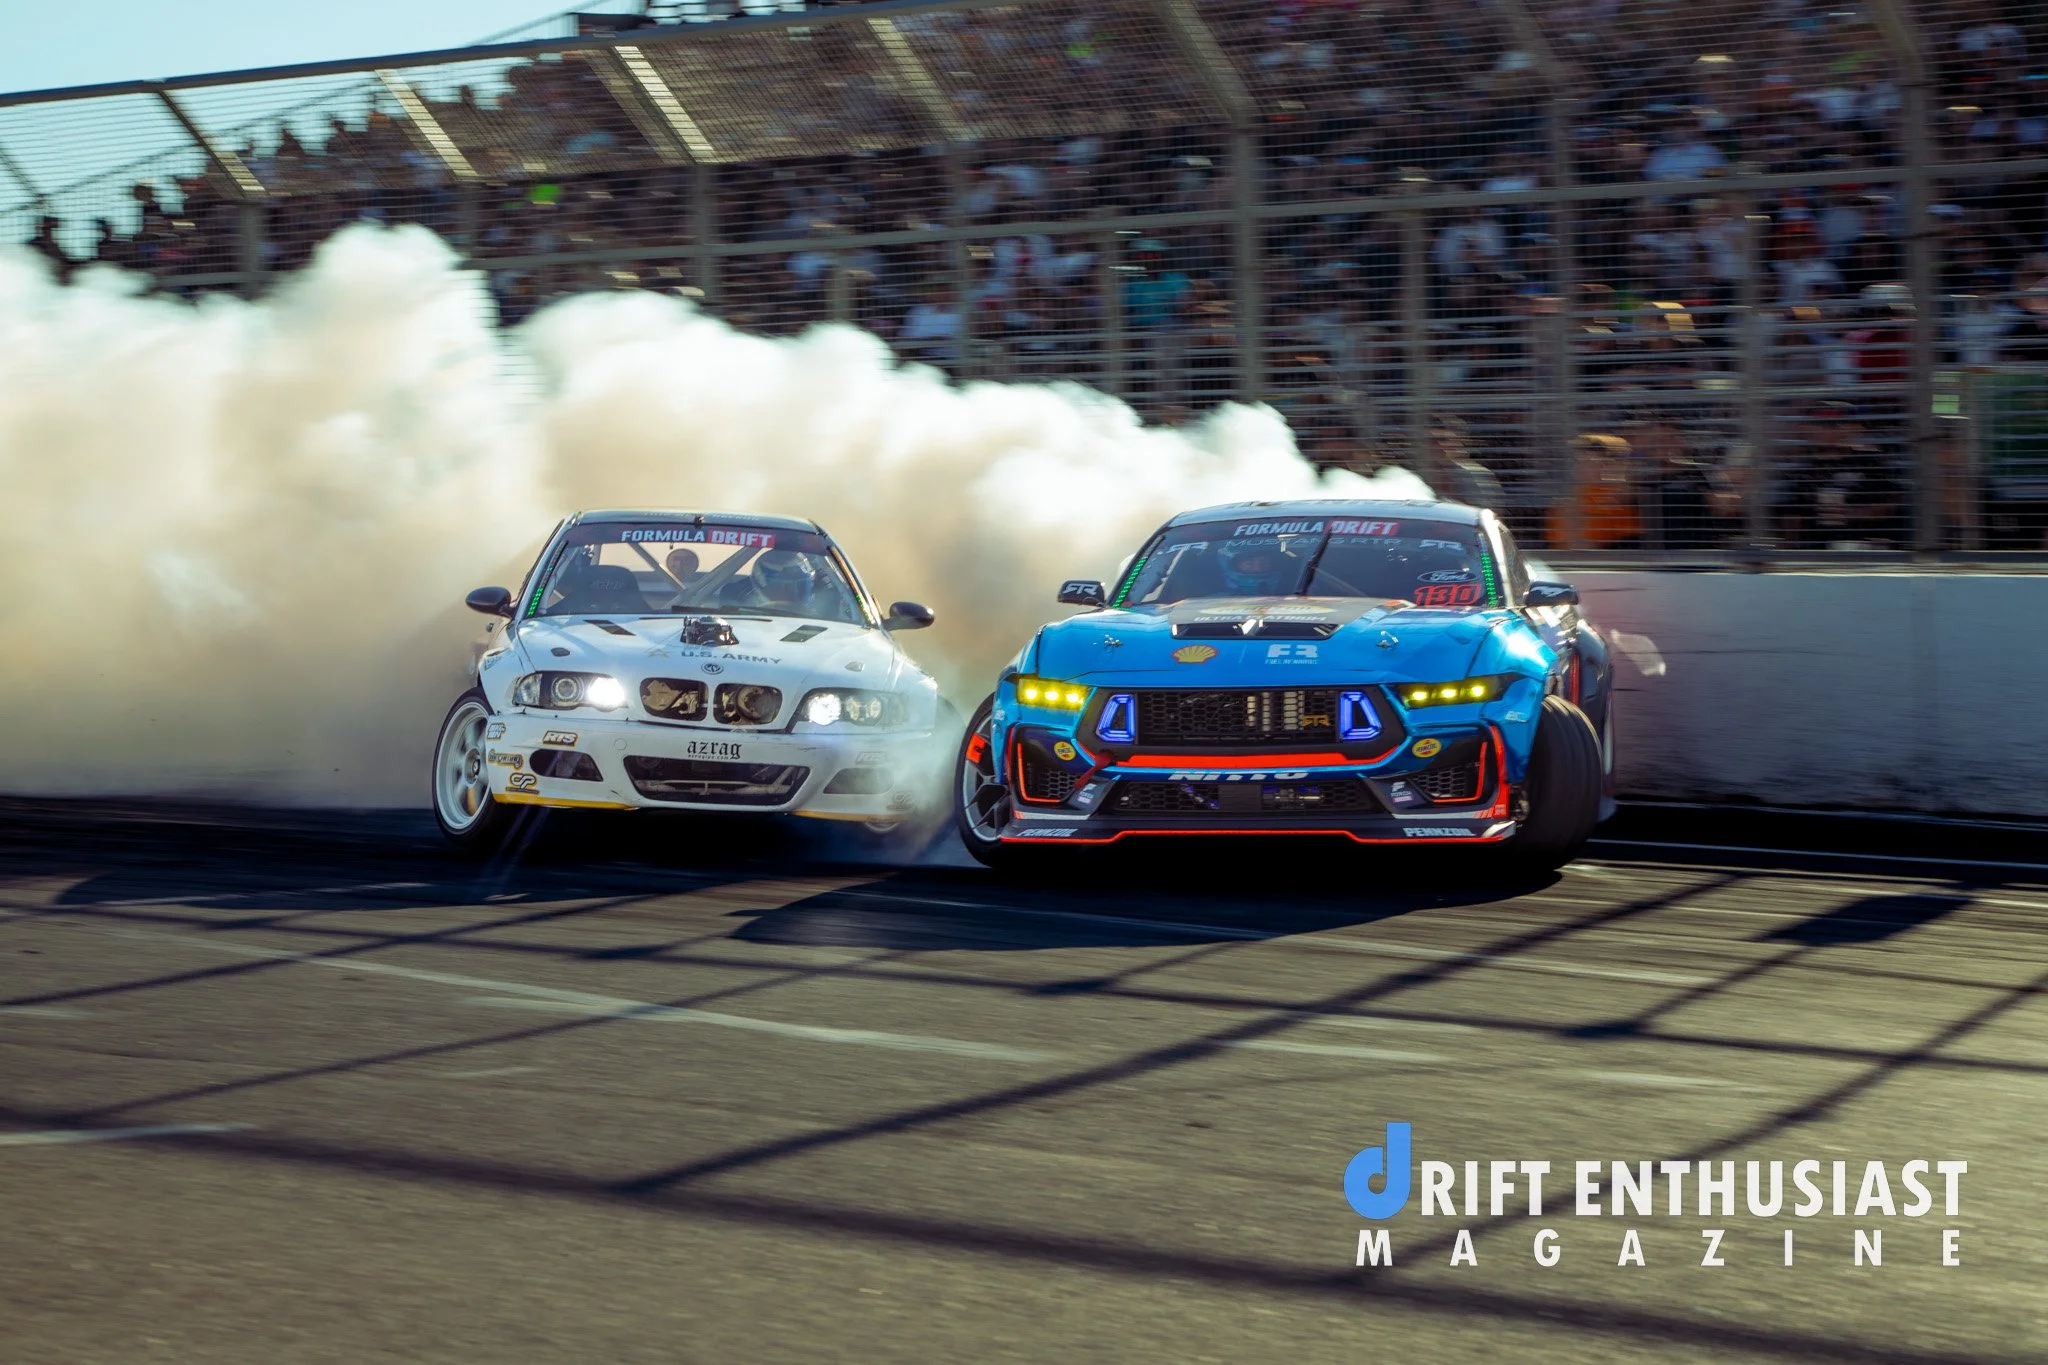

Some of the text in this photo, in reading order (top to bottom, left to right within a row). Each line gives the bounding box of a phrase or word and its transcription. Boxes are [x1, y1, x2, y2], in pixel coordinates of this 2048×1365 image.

[1233, 520, 1398, 536] FORMULA DRIFT
[621, 530, 772, 547] FORMULA DRIFT
[1414, 584, 1482, 606] 130
[722, 653, 781, 664] ARMY
[687, 741, 742, 760] azrag
[1168, 771, 1310, 781] NITTO
[1402, 827, 1477, 837] PENNZOIL
